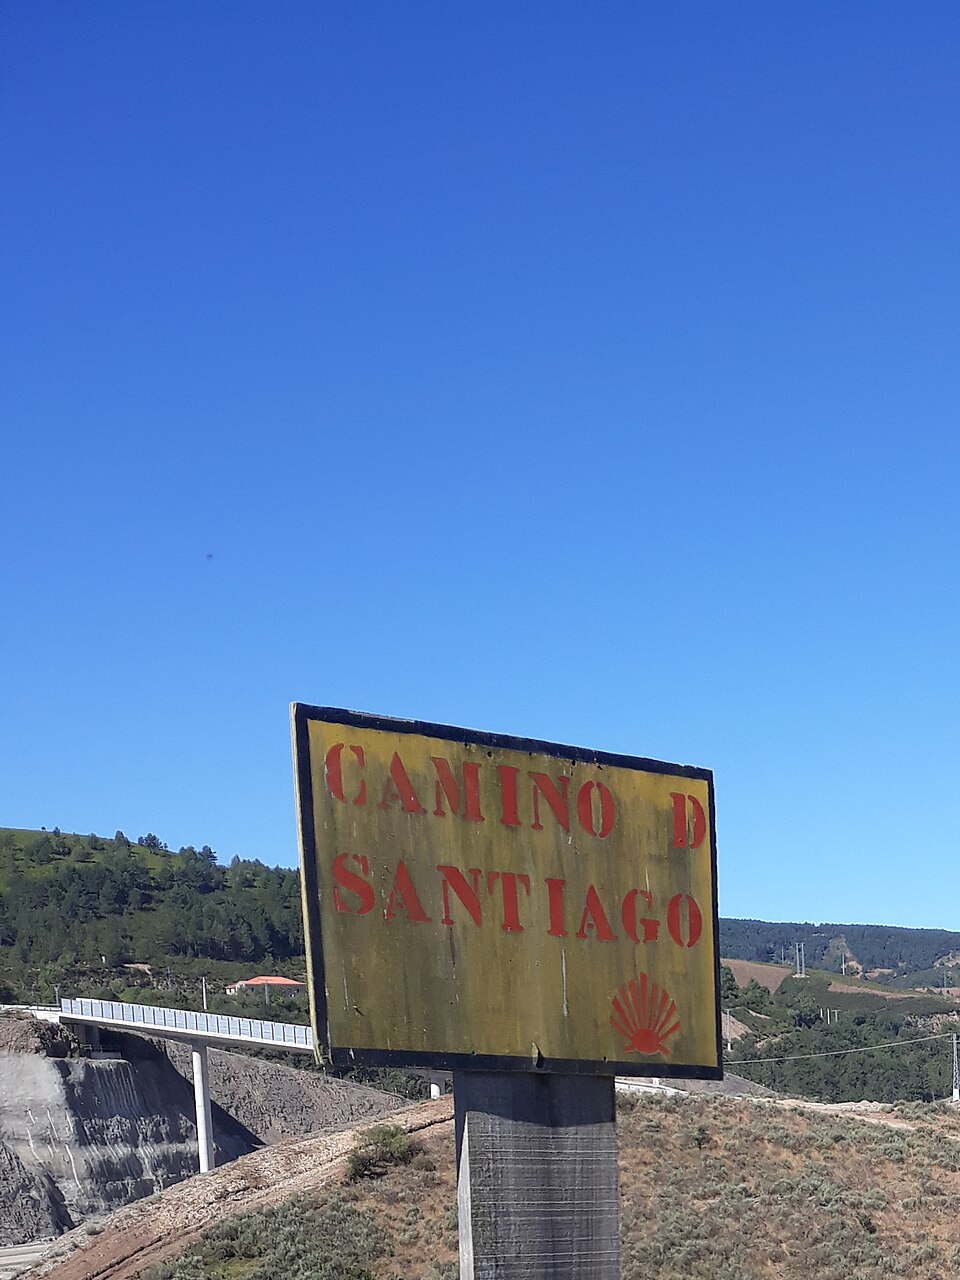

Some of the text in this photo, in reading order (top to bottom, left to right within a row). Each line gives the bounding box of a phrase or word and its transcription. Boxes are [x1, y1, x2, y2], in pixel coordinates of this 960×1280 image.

[325, 742, 706, 849] CAMINO D
[332, 852, 702, 949] SANTIAGO
